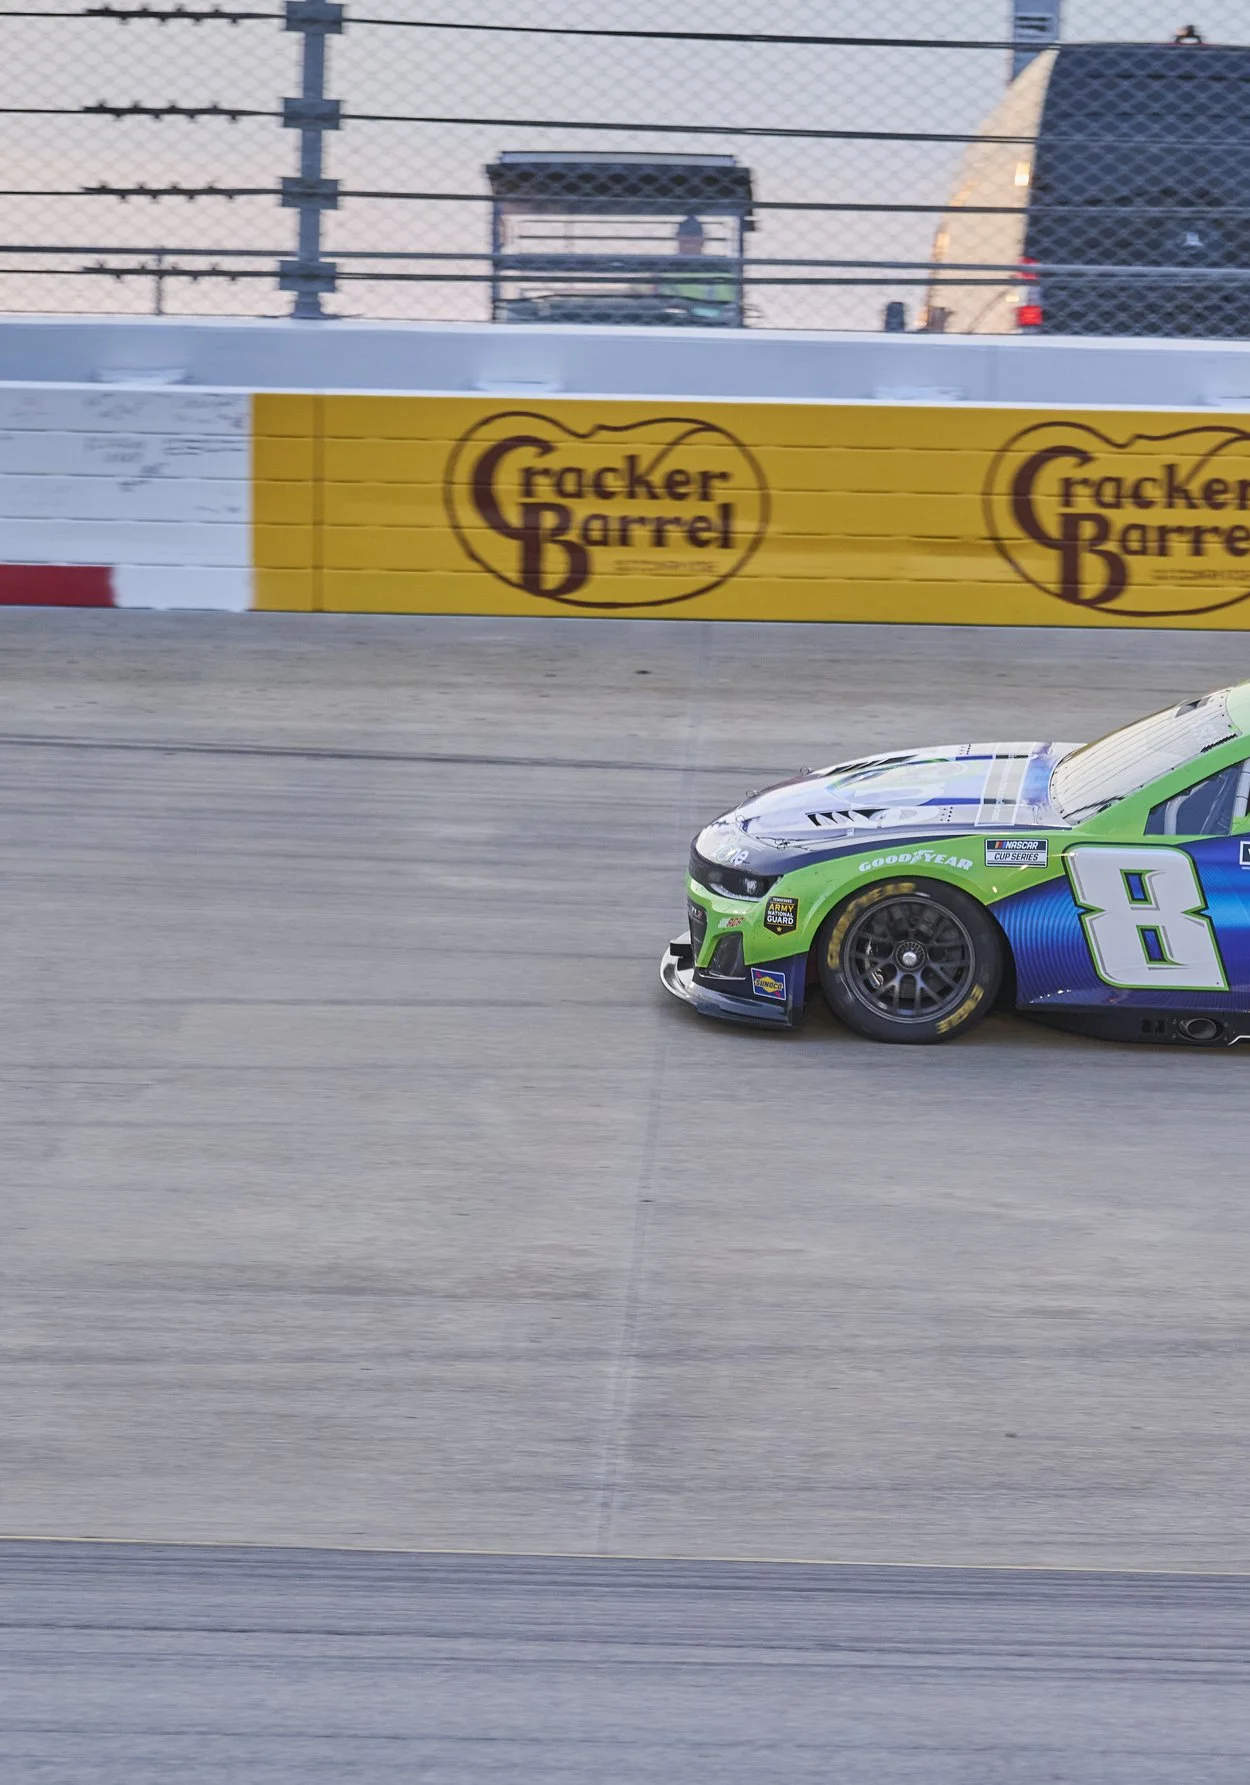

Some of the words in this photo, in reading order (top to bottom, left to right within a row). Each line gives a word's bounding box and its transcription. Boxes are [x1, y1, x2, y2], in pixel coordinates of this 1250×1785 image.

[472, 435, 733, 541] Cracker
[518, 502, 736, 598] Barrel
[1006, 841, 1039, 850] NASCAR
[858, 849, 974, 872] GOODYEAR
[994, 853, 1010, 861] CUP
[1011, 853, 1039, 861] SERIES
[769, 904, 795, 912] ARMY
[767, 915, 794, 925] GUARD
[1061, 841, 1230, 991] 8
[755, 979, 784, 990] SUNOCO
